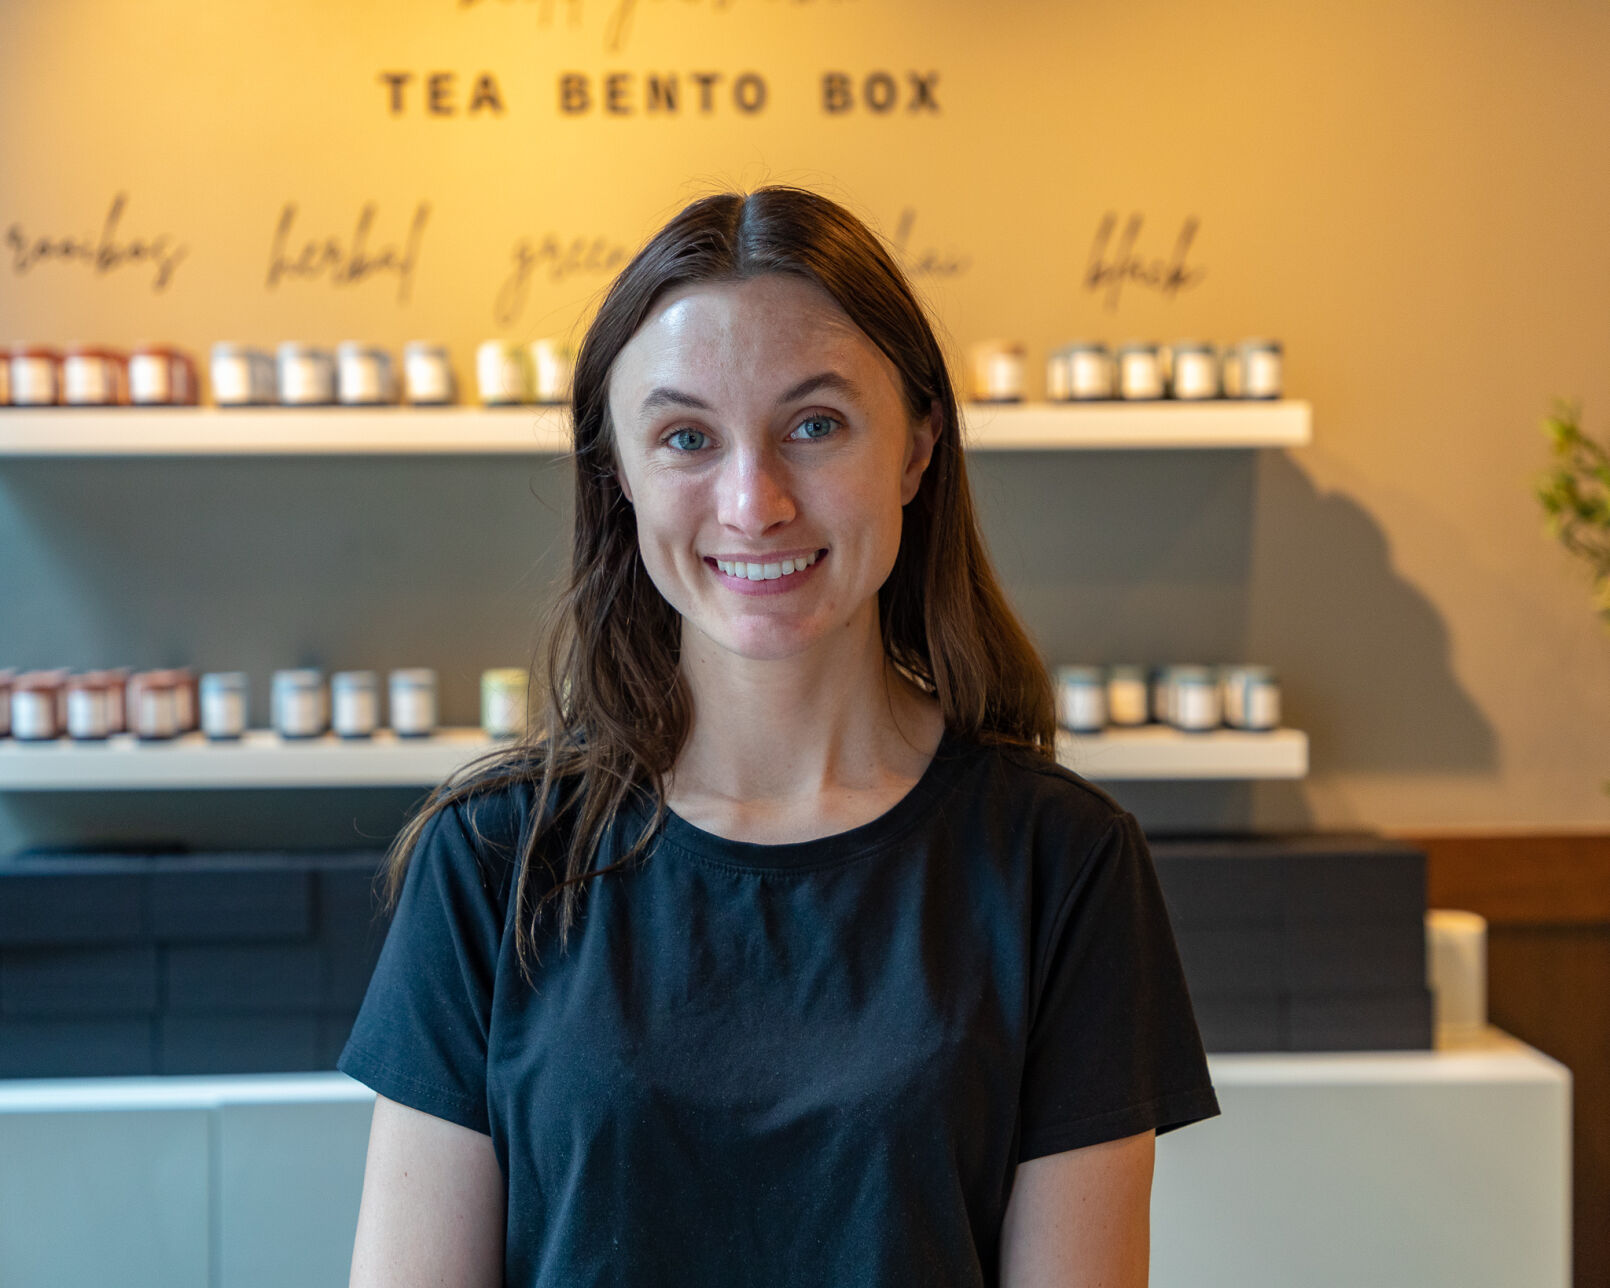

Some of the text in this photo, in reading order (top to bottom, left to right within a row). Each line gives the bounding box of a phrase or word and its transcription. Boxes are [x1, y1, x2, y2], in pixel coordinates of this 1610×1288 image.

[378, 70, 943, 117] TEA BENTO BOX
[265, 200, 431, 307] herbal
[1085, 210, 1205, 313] black
